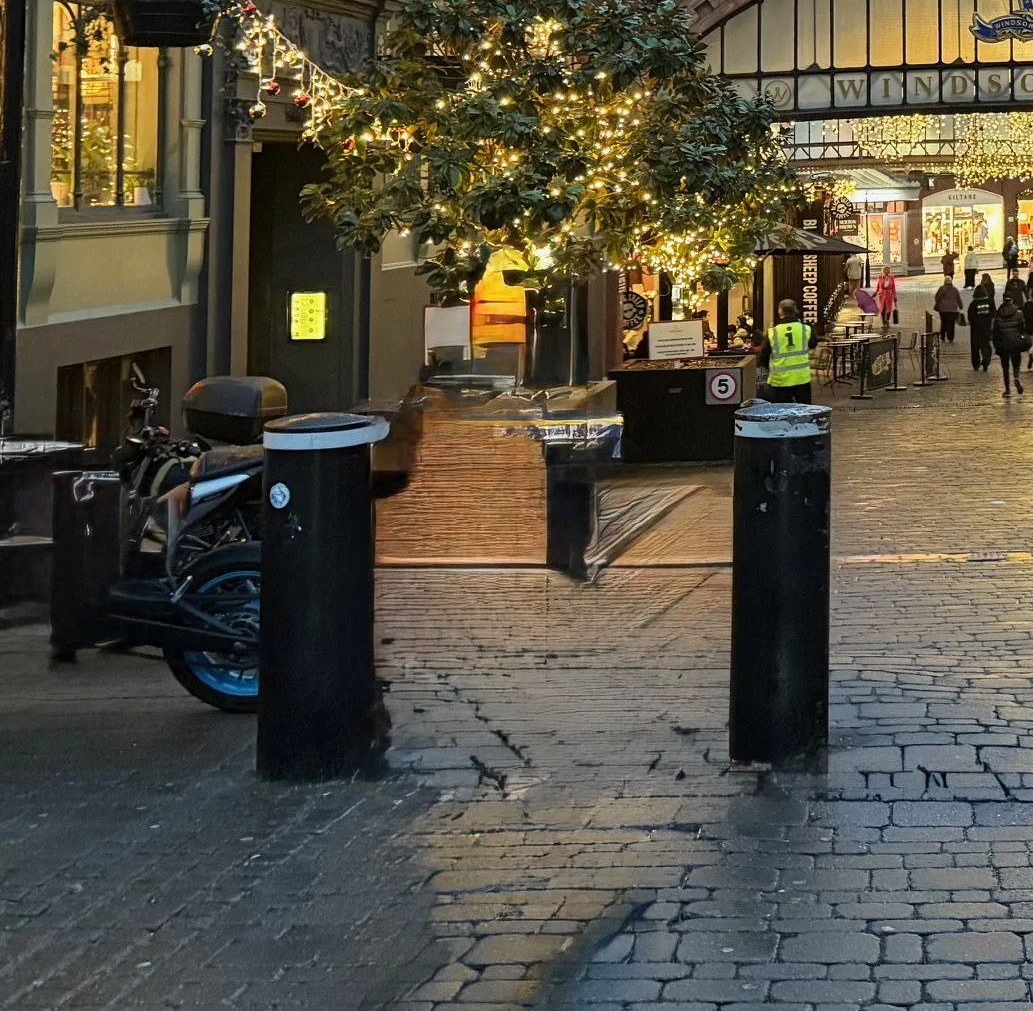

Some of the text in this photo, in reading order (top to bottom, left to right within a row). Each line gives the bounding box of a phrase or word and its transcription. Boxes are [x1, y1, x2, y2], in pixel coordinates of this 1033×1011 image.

[803, 254, 818, 323] SHEEP COFFEE
[785, 326, 796, 347] i
[718, 379, 729, 394] 5
